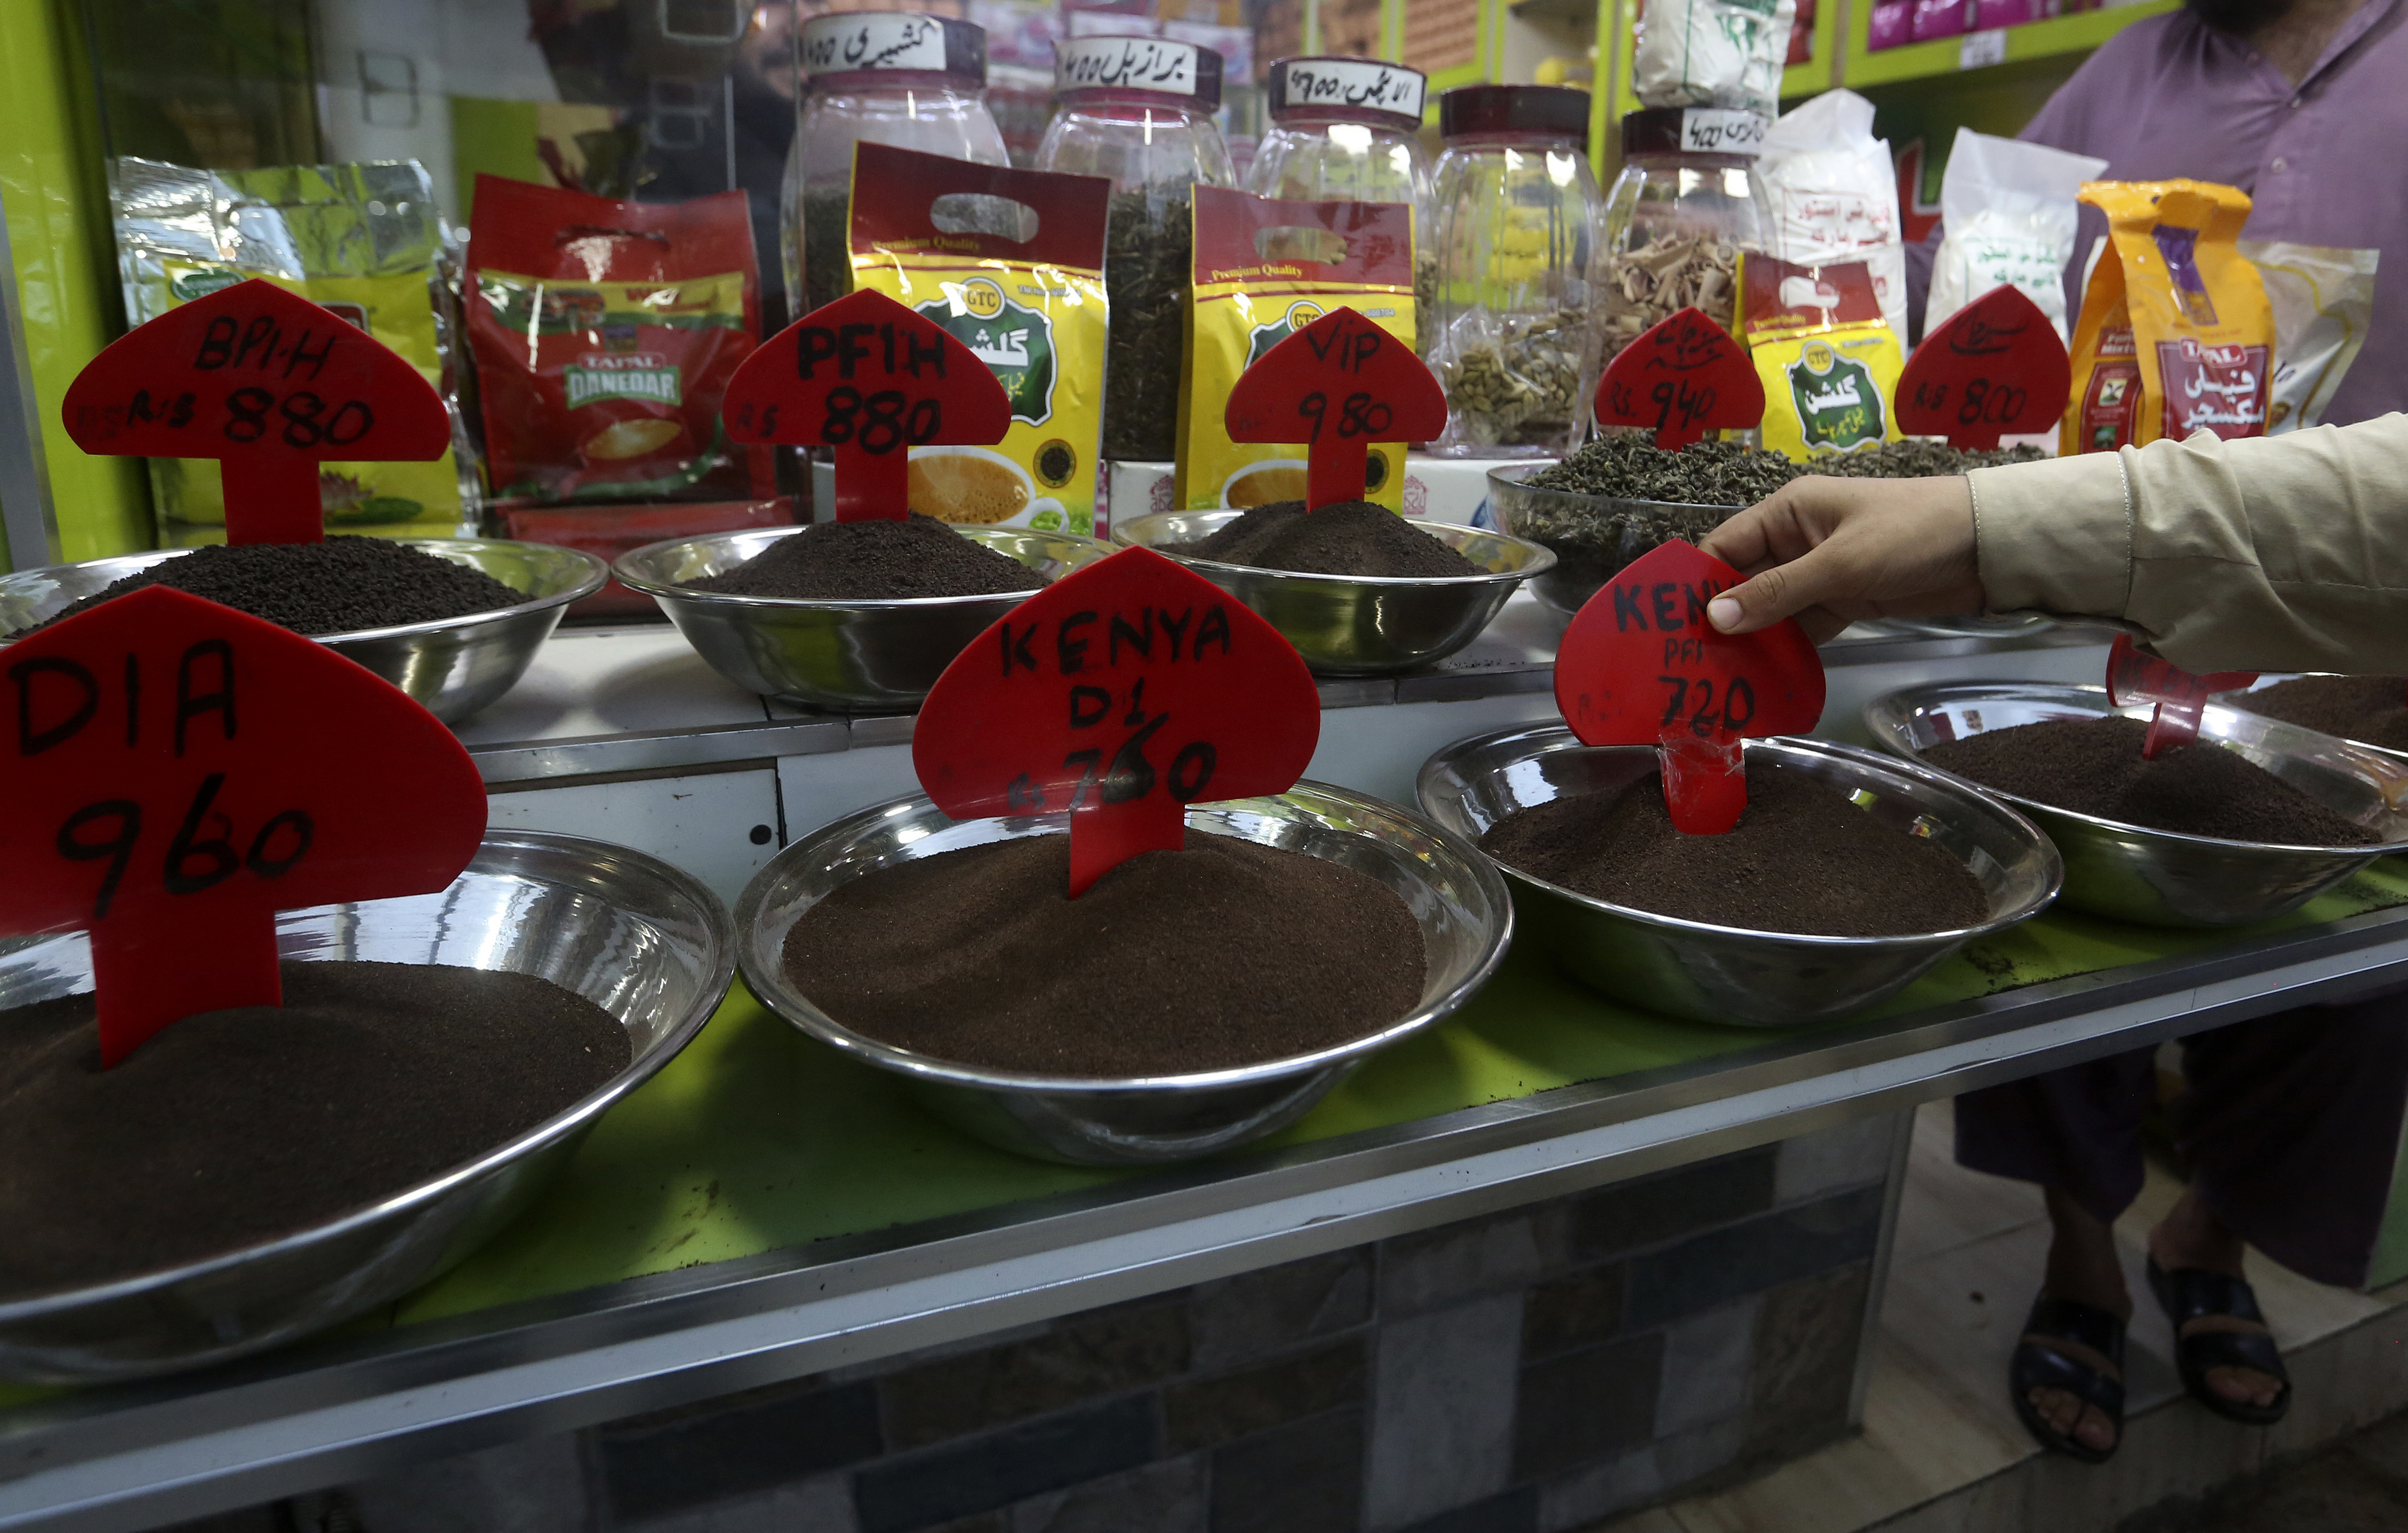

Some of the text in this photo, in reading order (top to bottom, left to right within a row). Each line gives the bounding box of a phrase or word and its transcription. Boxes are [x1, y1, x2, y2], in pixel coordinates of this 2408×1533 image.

[1211, 264, 1303, 281] Premium Quality
[968, 291, 996, 307] GTC
[968, 328, 1029, 367] گلش
[568, 372, 677, 402] DANEDAR
[1652, 379, 1716, 431] 940
[1959, 378, 2026, 426] 800
[223, 387, 375, 448] 880
[820, 386, 942, 455] 880
[1299, 392, 1392, 444] 980
[1614, 581, 1735, 632] KEN
[1001, 605, 1231, 677] KENYA
[9, 639, 237, 757] DIA
[1071, 677, 1145, 729] D1
[1658, 675, 1755, 737] 720
[1064, 712, 1216, 813] 760
[57, 773, 316, 919] 960
